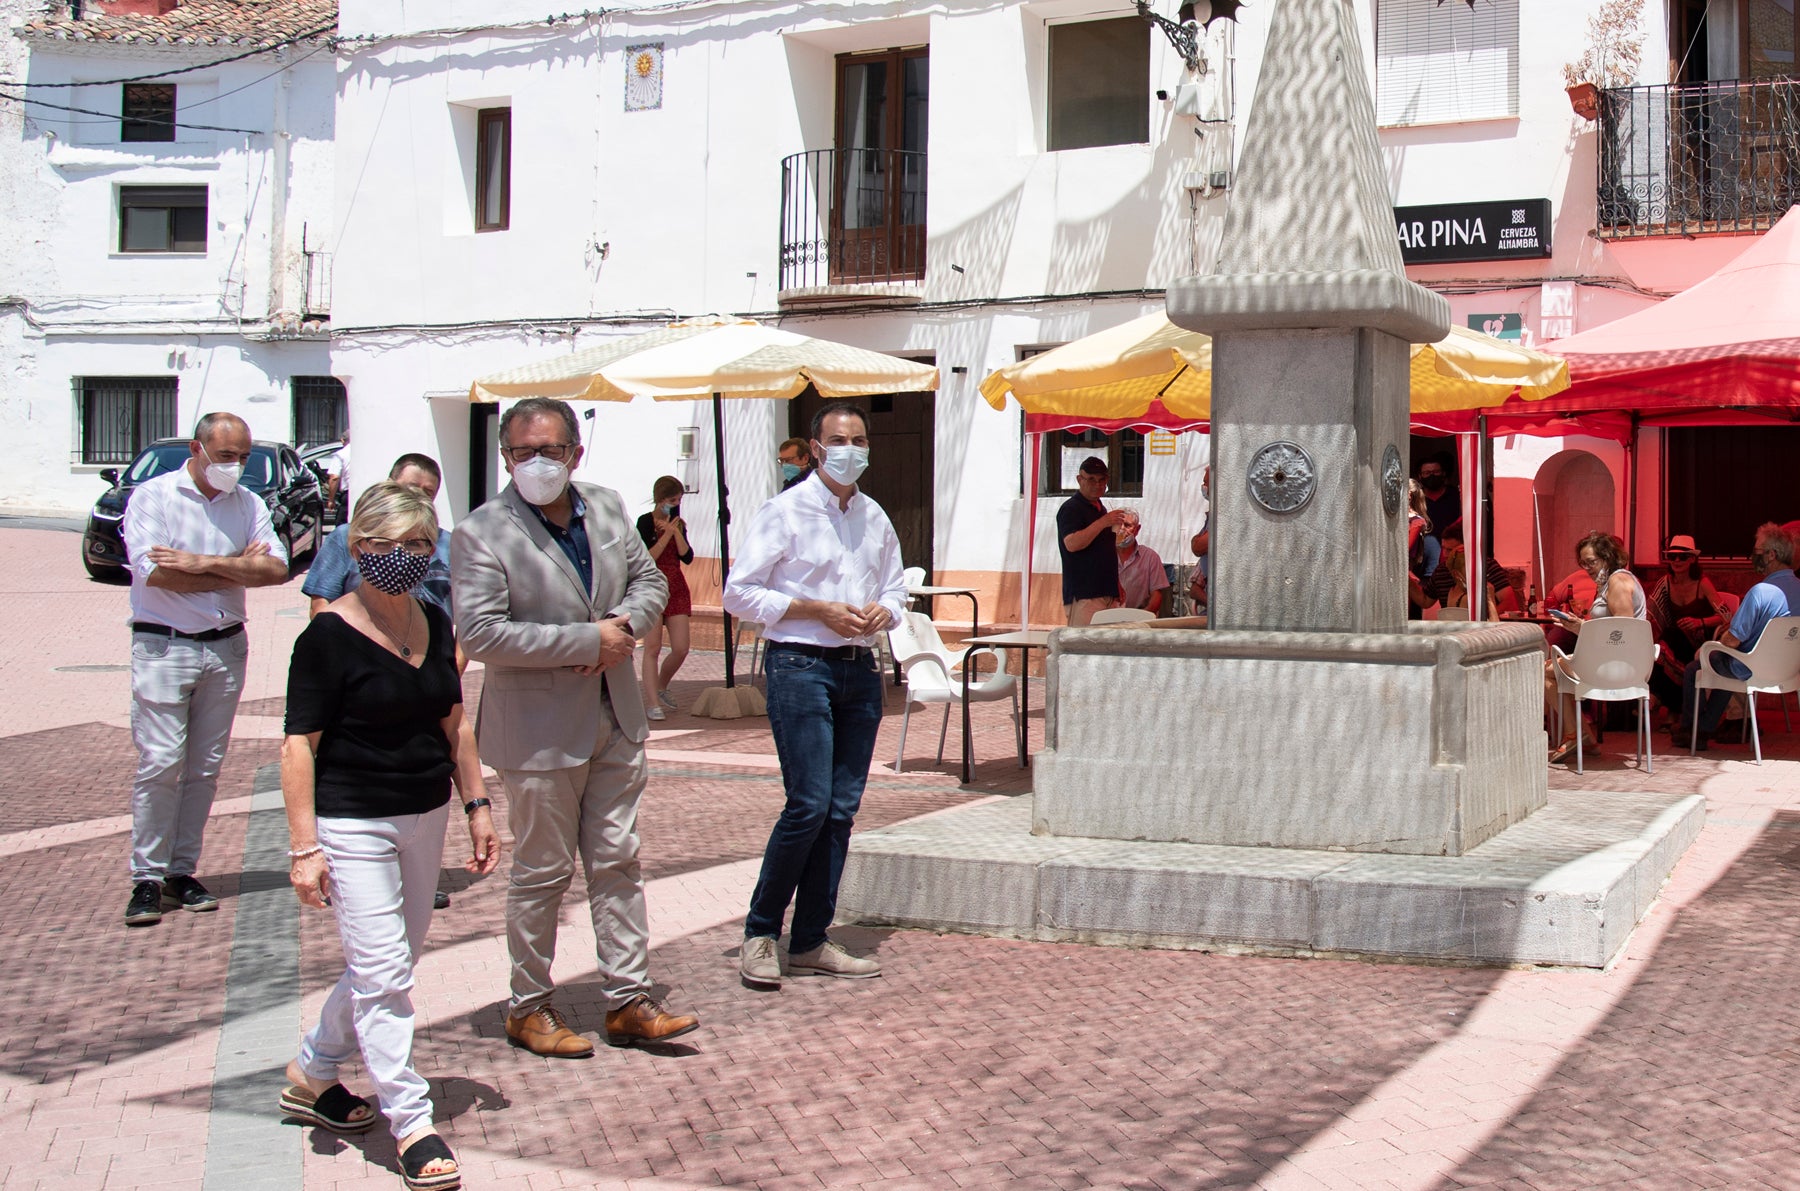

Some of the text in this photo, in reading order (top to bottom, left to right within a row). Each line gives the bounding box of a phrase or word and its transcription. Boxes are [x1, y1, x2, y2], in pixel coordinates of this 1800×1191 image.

[1431, 217, 1486, 247] PINA
[1500, 226, 1537, 239] CERVEZAS
[1498, 238, 1539, 250] ALHAMBRA
